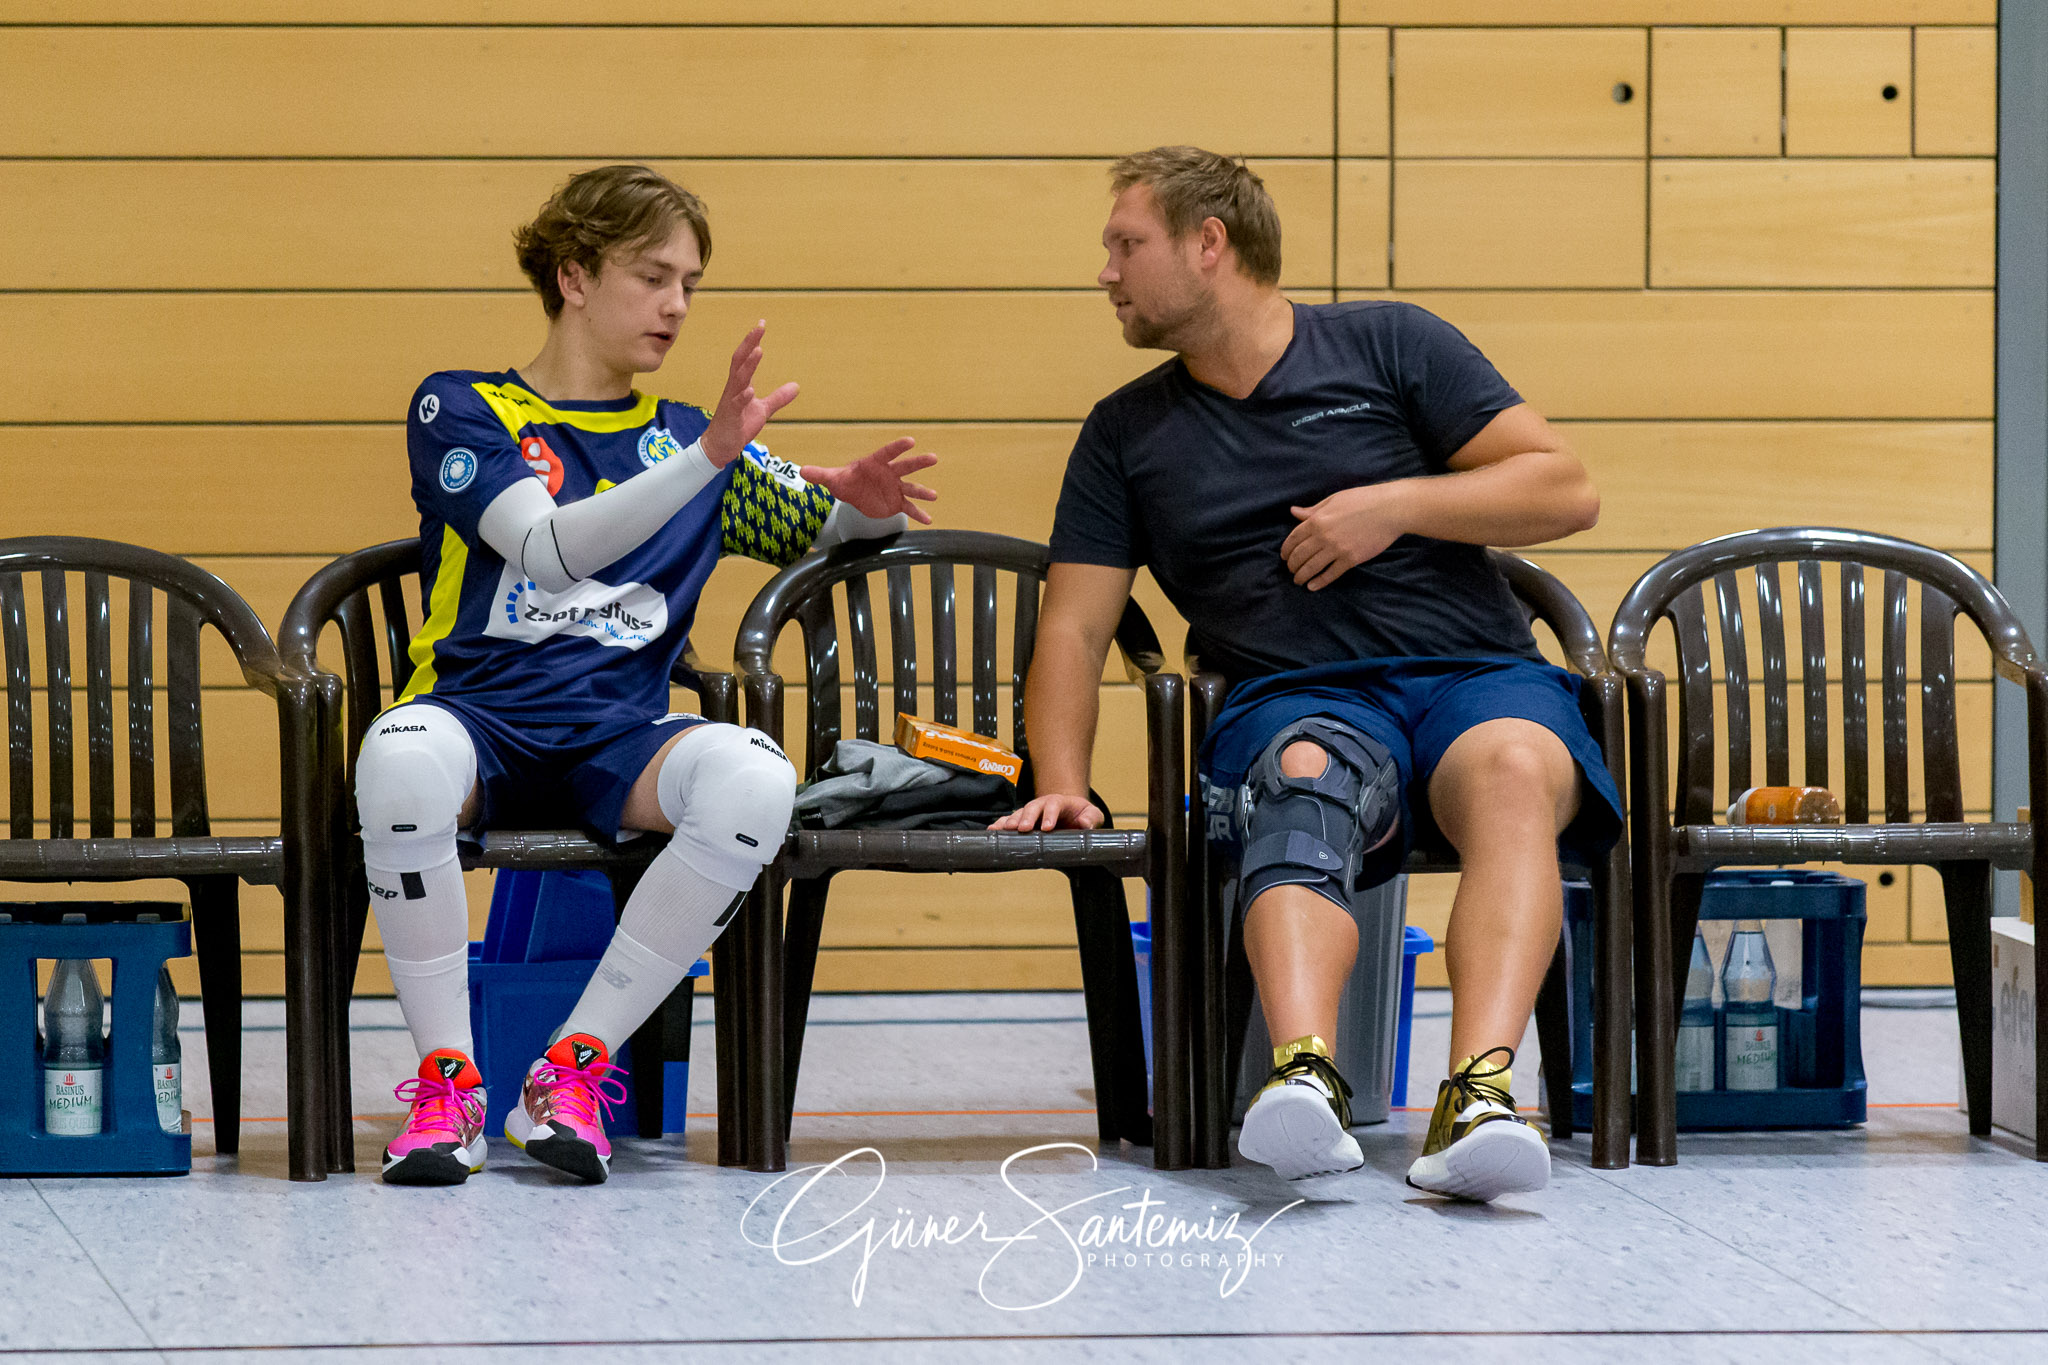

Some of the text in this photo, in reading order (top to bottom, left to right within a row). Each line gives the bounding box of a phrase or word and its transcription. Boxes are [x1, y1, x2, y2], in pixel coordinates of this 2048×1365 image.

[1291, 402, 1371, 428] UNDER ARMOUR
[524, 603, 579, 622] Zapf
[379, 724, 428, 736] MIKASA
[750, 737, 789, 763] MIKASA
[55, 1084, 85, 1095] BASINUS
[49, 1096, 92, 1110] MEDIUM
[157, 1090, 180, 1104] EDIU
